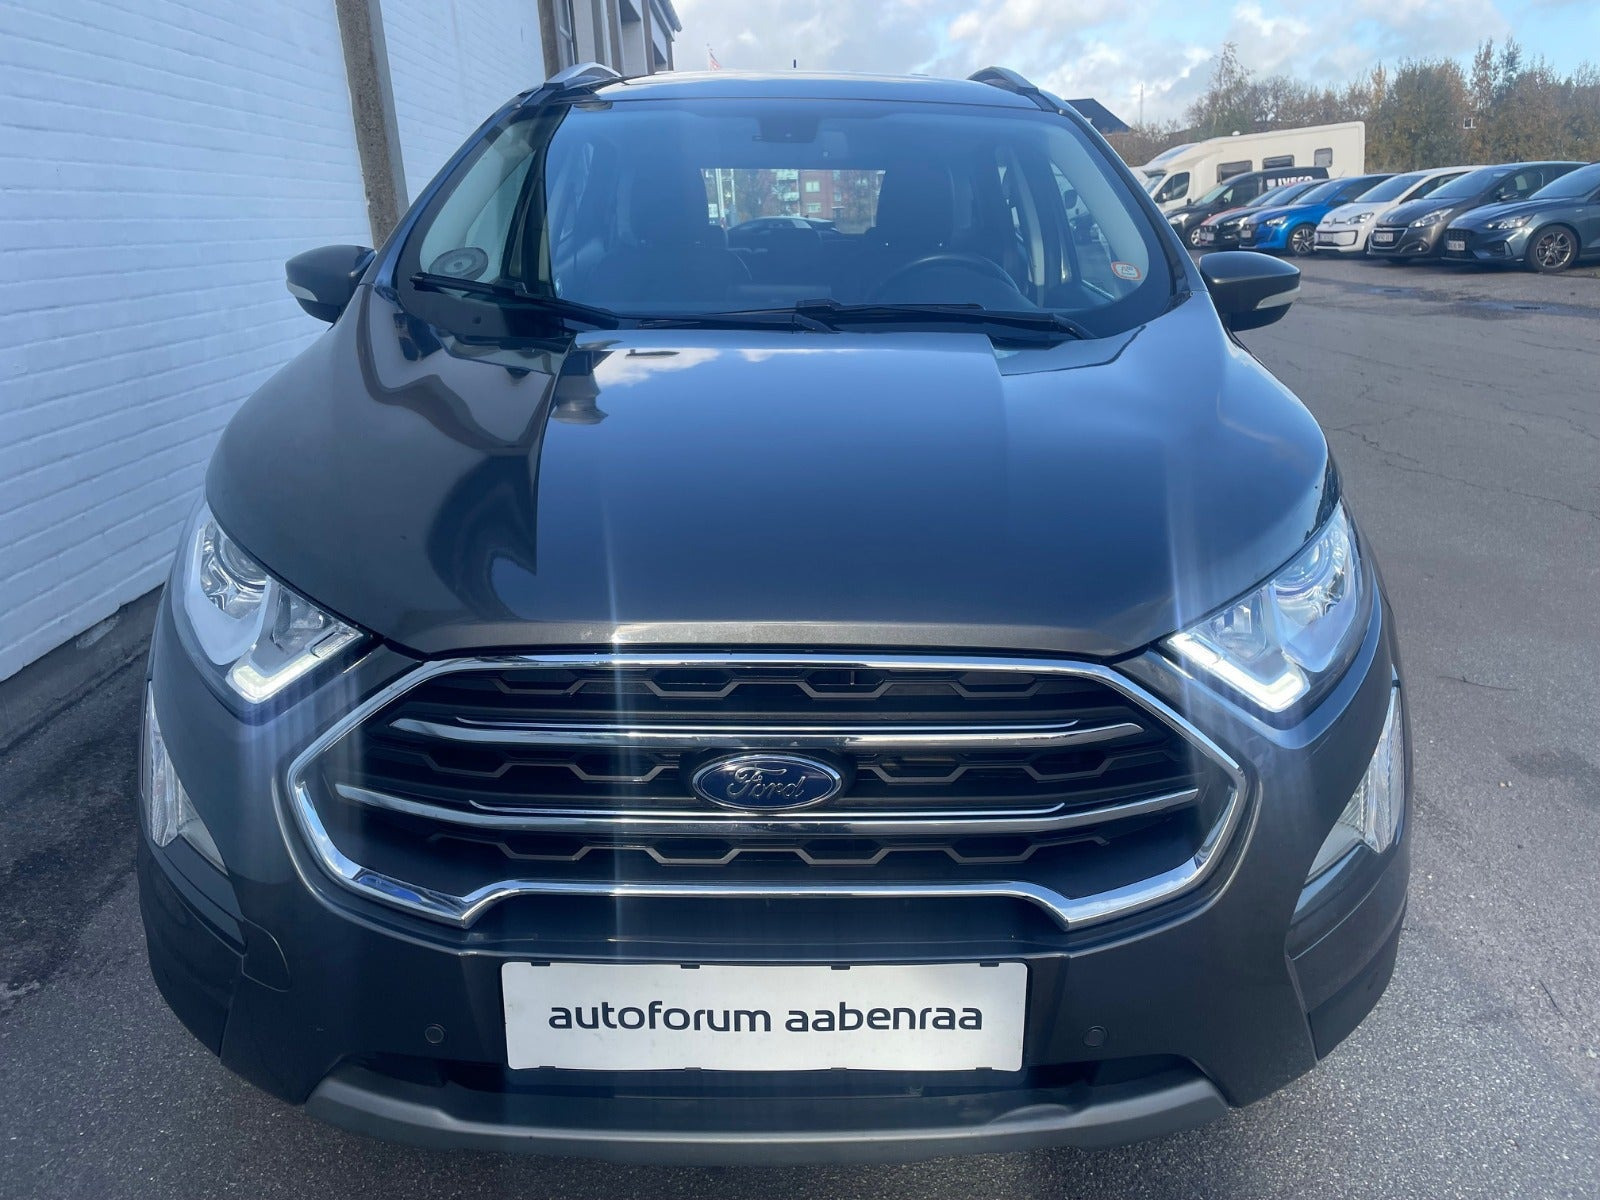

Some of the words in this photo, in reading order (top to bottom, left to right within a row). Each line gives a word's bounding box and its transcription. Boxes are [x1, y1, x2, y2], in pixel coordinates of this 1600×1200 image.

[726, 765, 806, 799] Ford
[548, 1001, 771, 1032] autoforum
[785, 1002, 982, 1032] aabenraa
